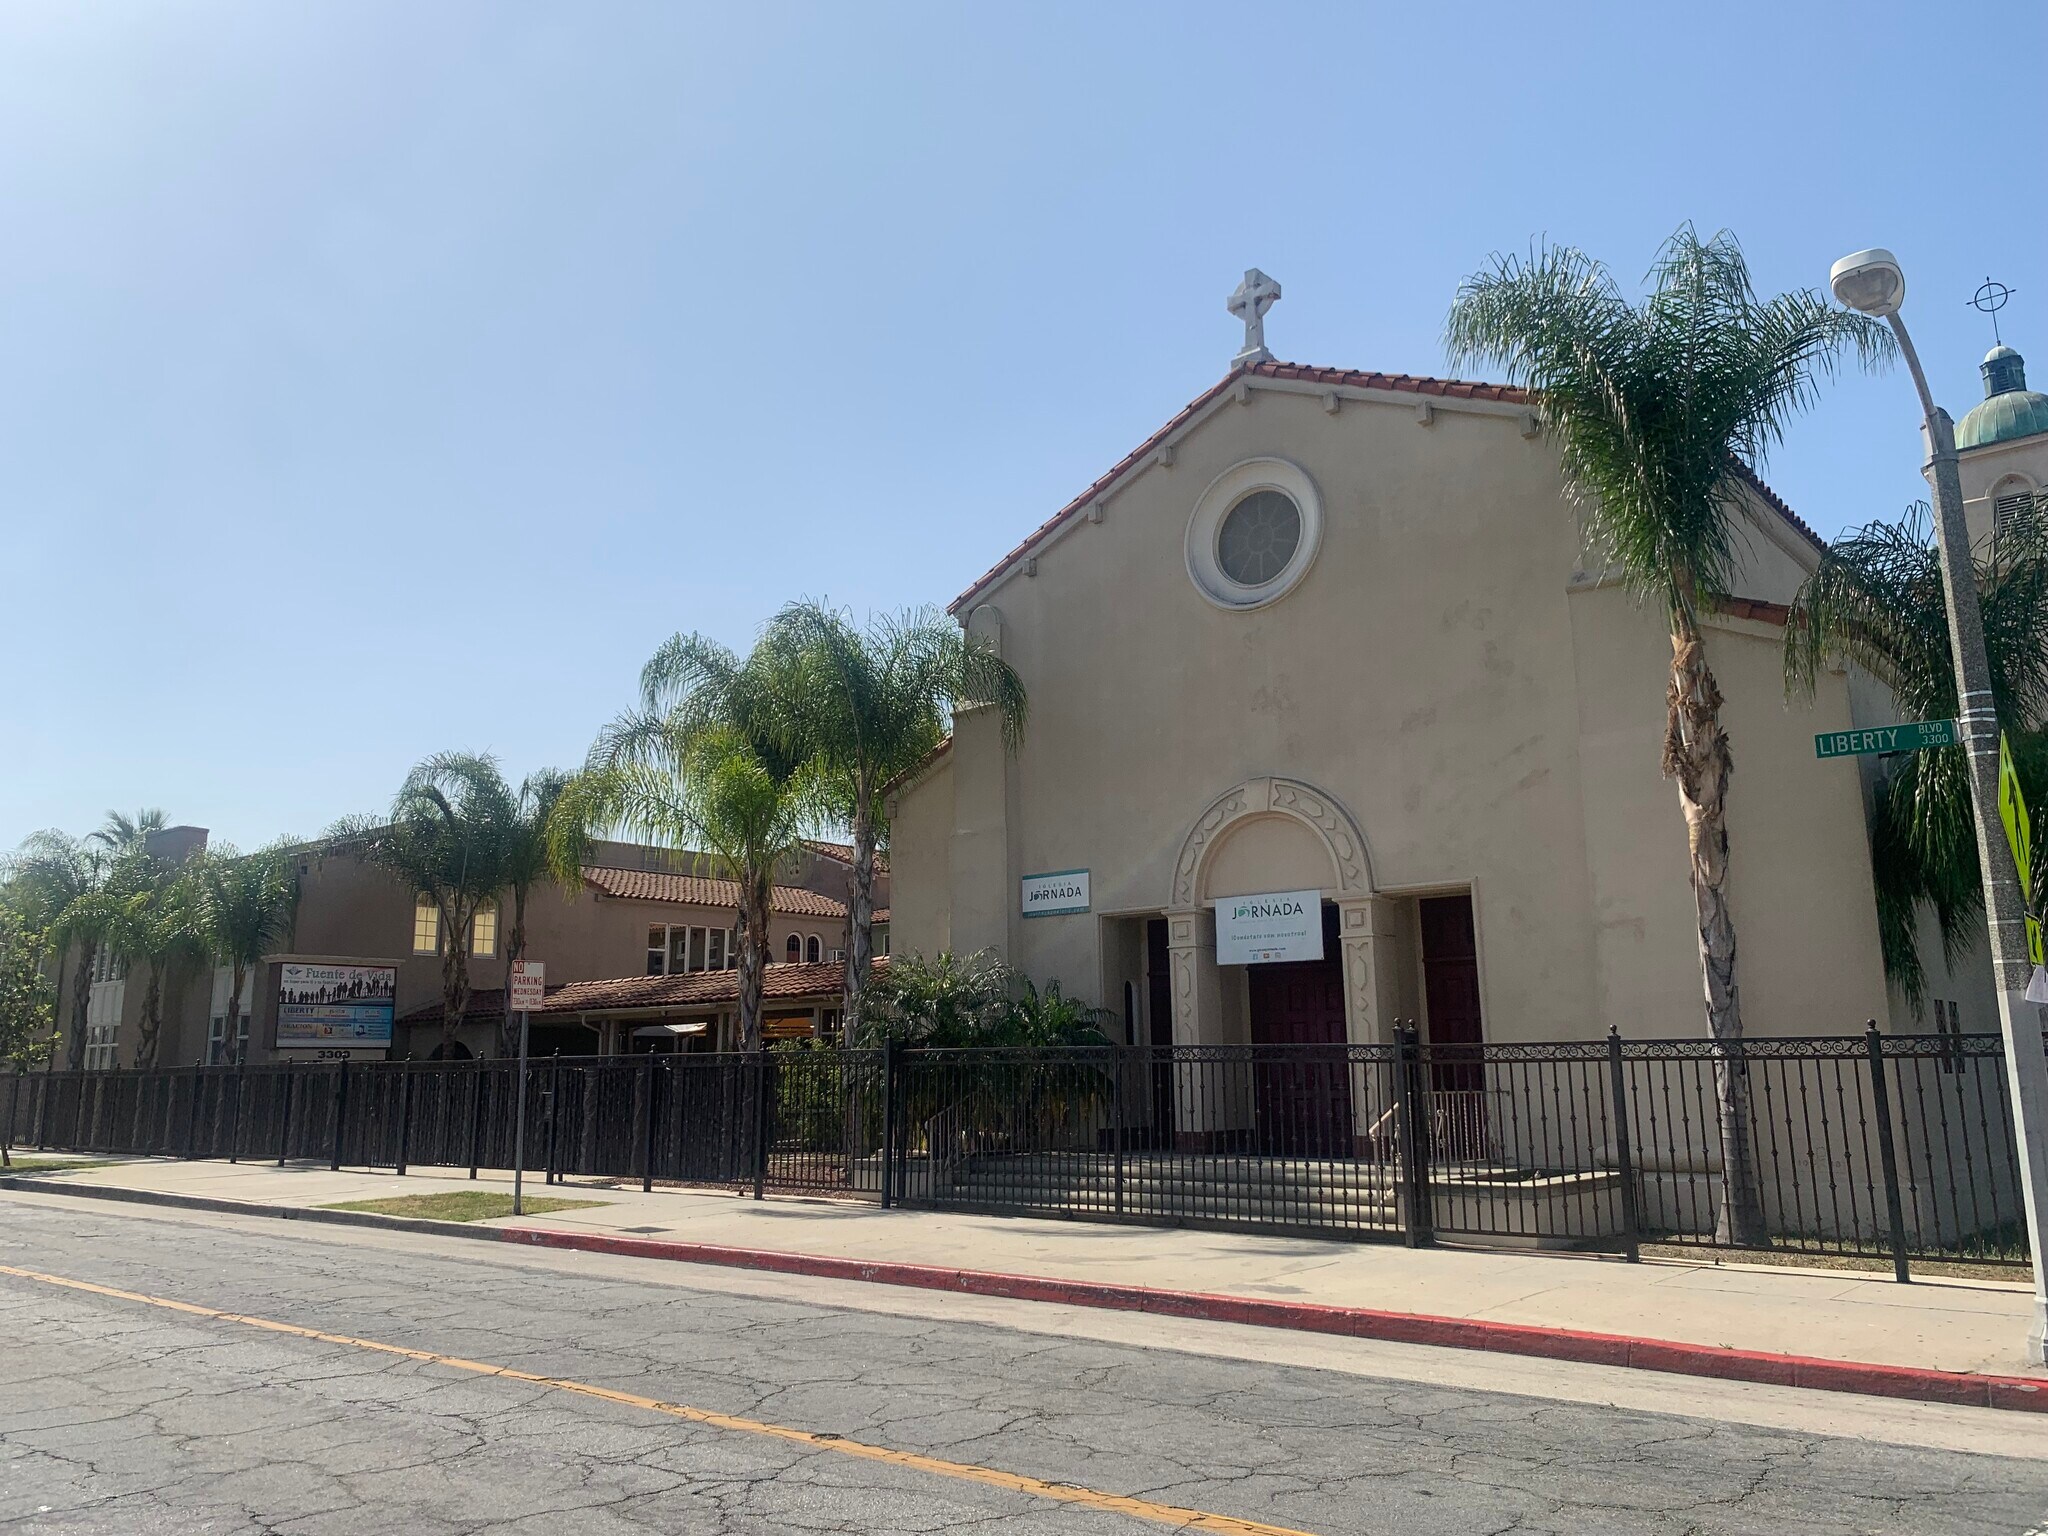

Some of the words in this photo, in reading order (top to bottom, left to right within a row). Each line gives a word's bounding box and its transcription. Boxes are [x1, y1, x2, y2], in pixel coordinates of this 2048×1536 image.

[1818, 729, 1898, 755] LIBERTY
[1918, 722, 1943, 734] BLVD
[1921, 734, 1949, 745] 3300
[1029, 886, 1082, 902] JORNADA
[1232, 902, 1303, 920] JORNADA
[514, 961, 524, 972] NO
[306, 967, 346, 980] Fuente
[349, 969, 363, 980] de
[367, 970, 392, 981] Vida
[514, 976, 542, 985] PARKING
